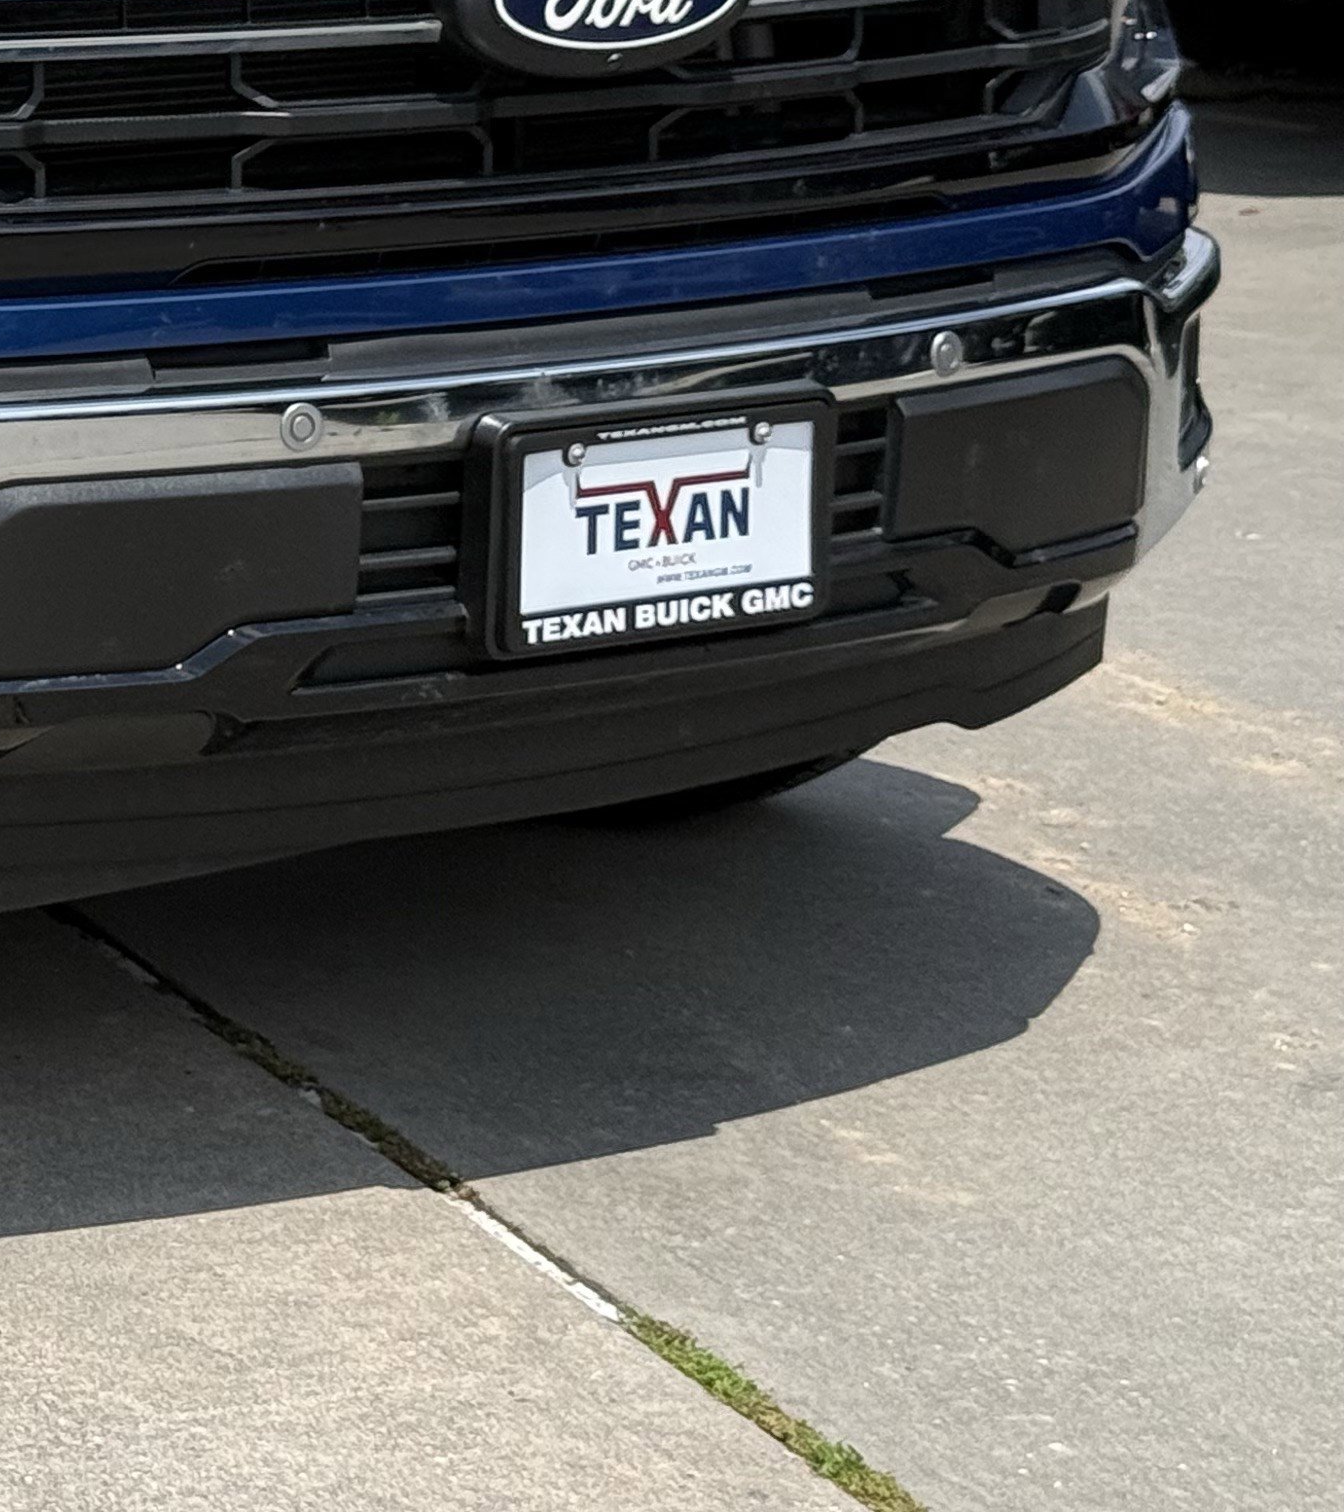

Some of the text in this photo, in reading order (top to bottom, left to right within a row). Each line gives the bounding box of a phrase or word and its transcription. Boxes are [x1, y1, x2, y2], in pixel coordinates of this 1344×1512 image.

[575, 468, 750, 556] TEXAN
[521, 582, 814, 644] TEXAN BUICK GMC
